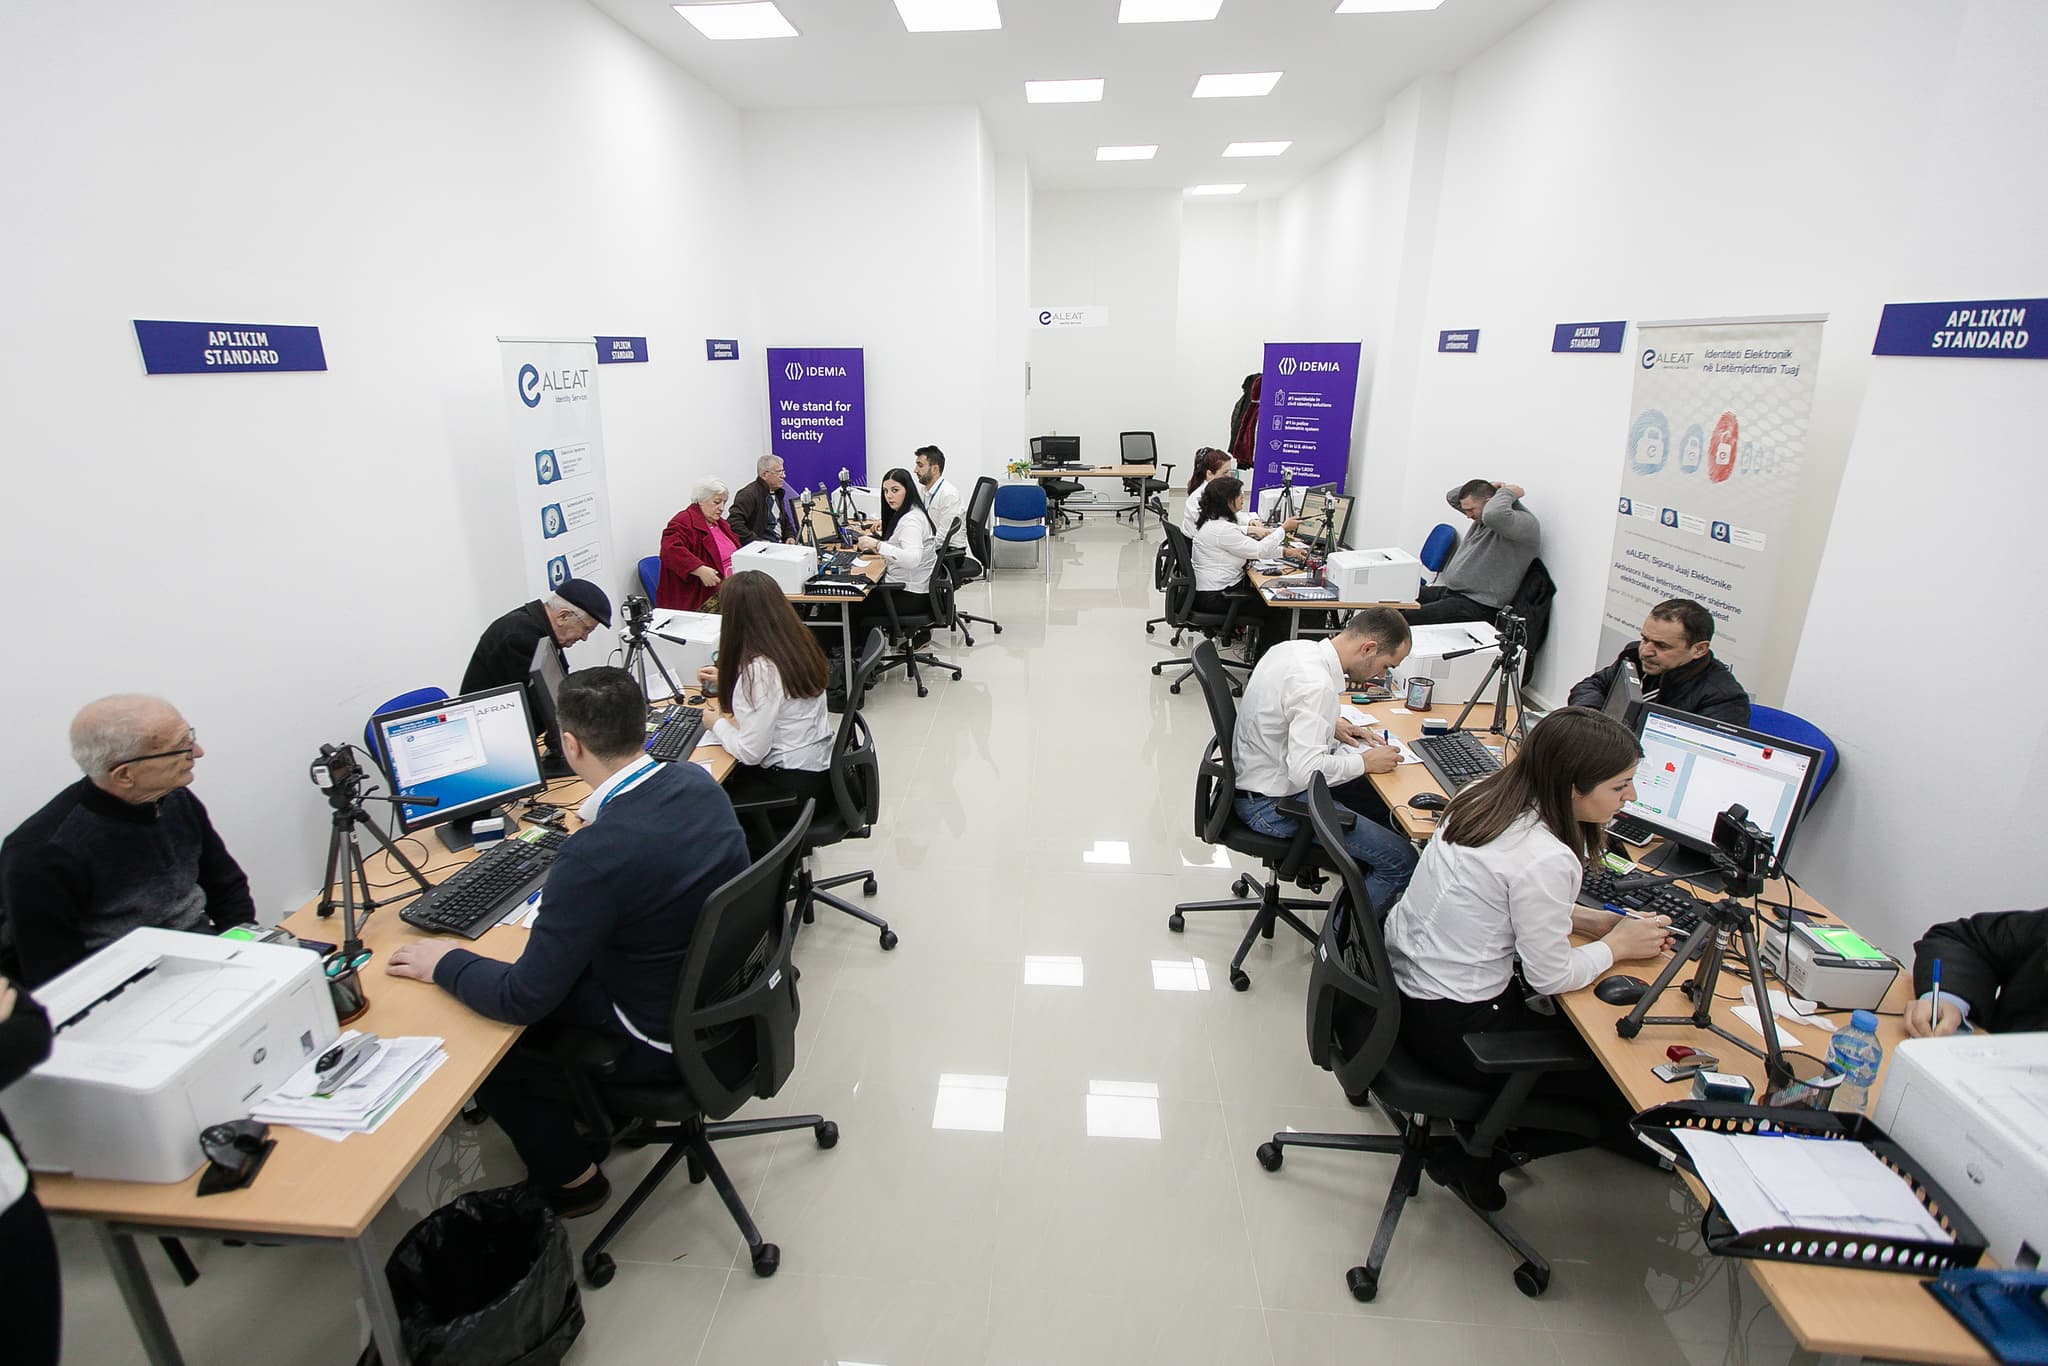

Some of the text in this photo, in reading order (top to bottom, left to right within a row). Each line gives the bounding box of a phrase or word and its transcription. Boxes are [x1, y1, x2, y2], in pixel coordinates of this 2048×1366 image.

[1946, 308, 2026, 327] APLIKIM
[208, 330, 269, 347] APLIKIM
[1574, 327, 1600, 337] APLIKIM
[1569, 338, 1601, 349] STANDARD
[1931, 330, 2029, 349] STANDARD
[204, 349, 279, 365] STANDARD
[1704, 350, 1793, 360] Identiteti Elektronik
[806, 366, 847, 377] IDEMIA
[1299, 361, 1340, 372] IDEMIA
[1780, 364, 1800, 377] Tuaj
[780, 400, 851, 411] We stand for
[780, 415, 844, 428] augmented
[781, 430, 824, 443] identity
[1690, 569, 1733, 591] Elektronike
[476, 702, 515, 716] AFRAN
